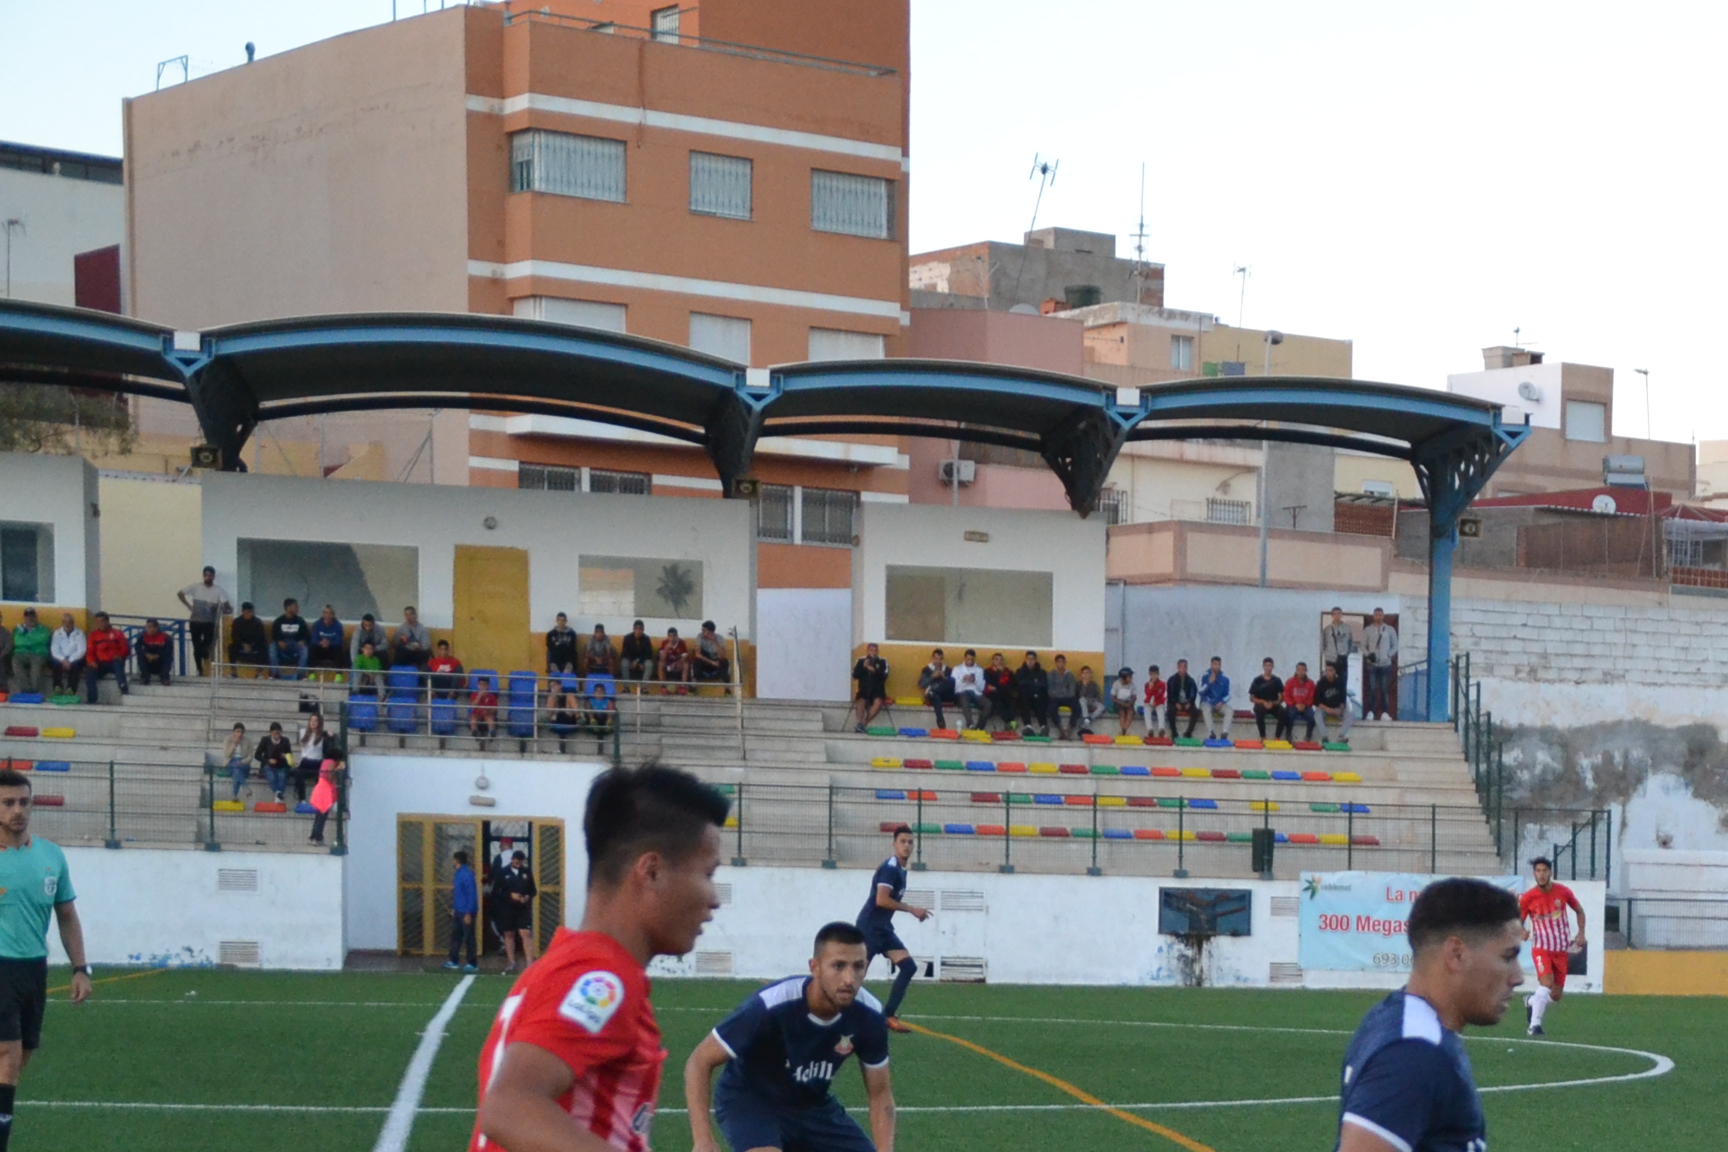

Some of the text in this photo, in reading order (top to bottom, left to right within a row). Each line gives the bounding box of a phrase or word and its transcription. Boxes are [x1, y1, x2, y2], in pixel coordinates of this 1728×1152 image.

[1386, 886, 1404, 902] La
[1318, 914, 1350, 932] 300
[1373, 953, 1399, 966] 693
